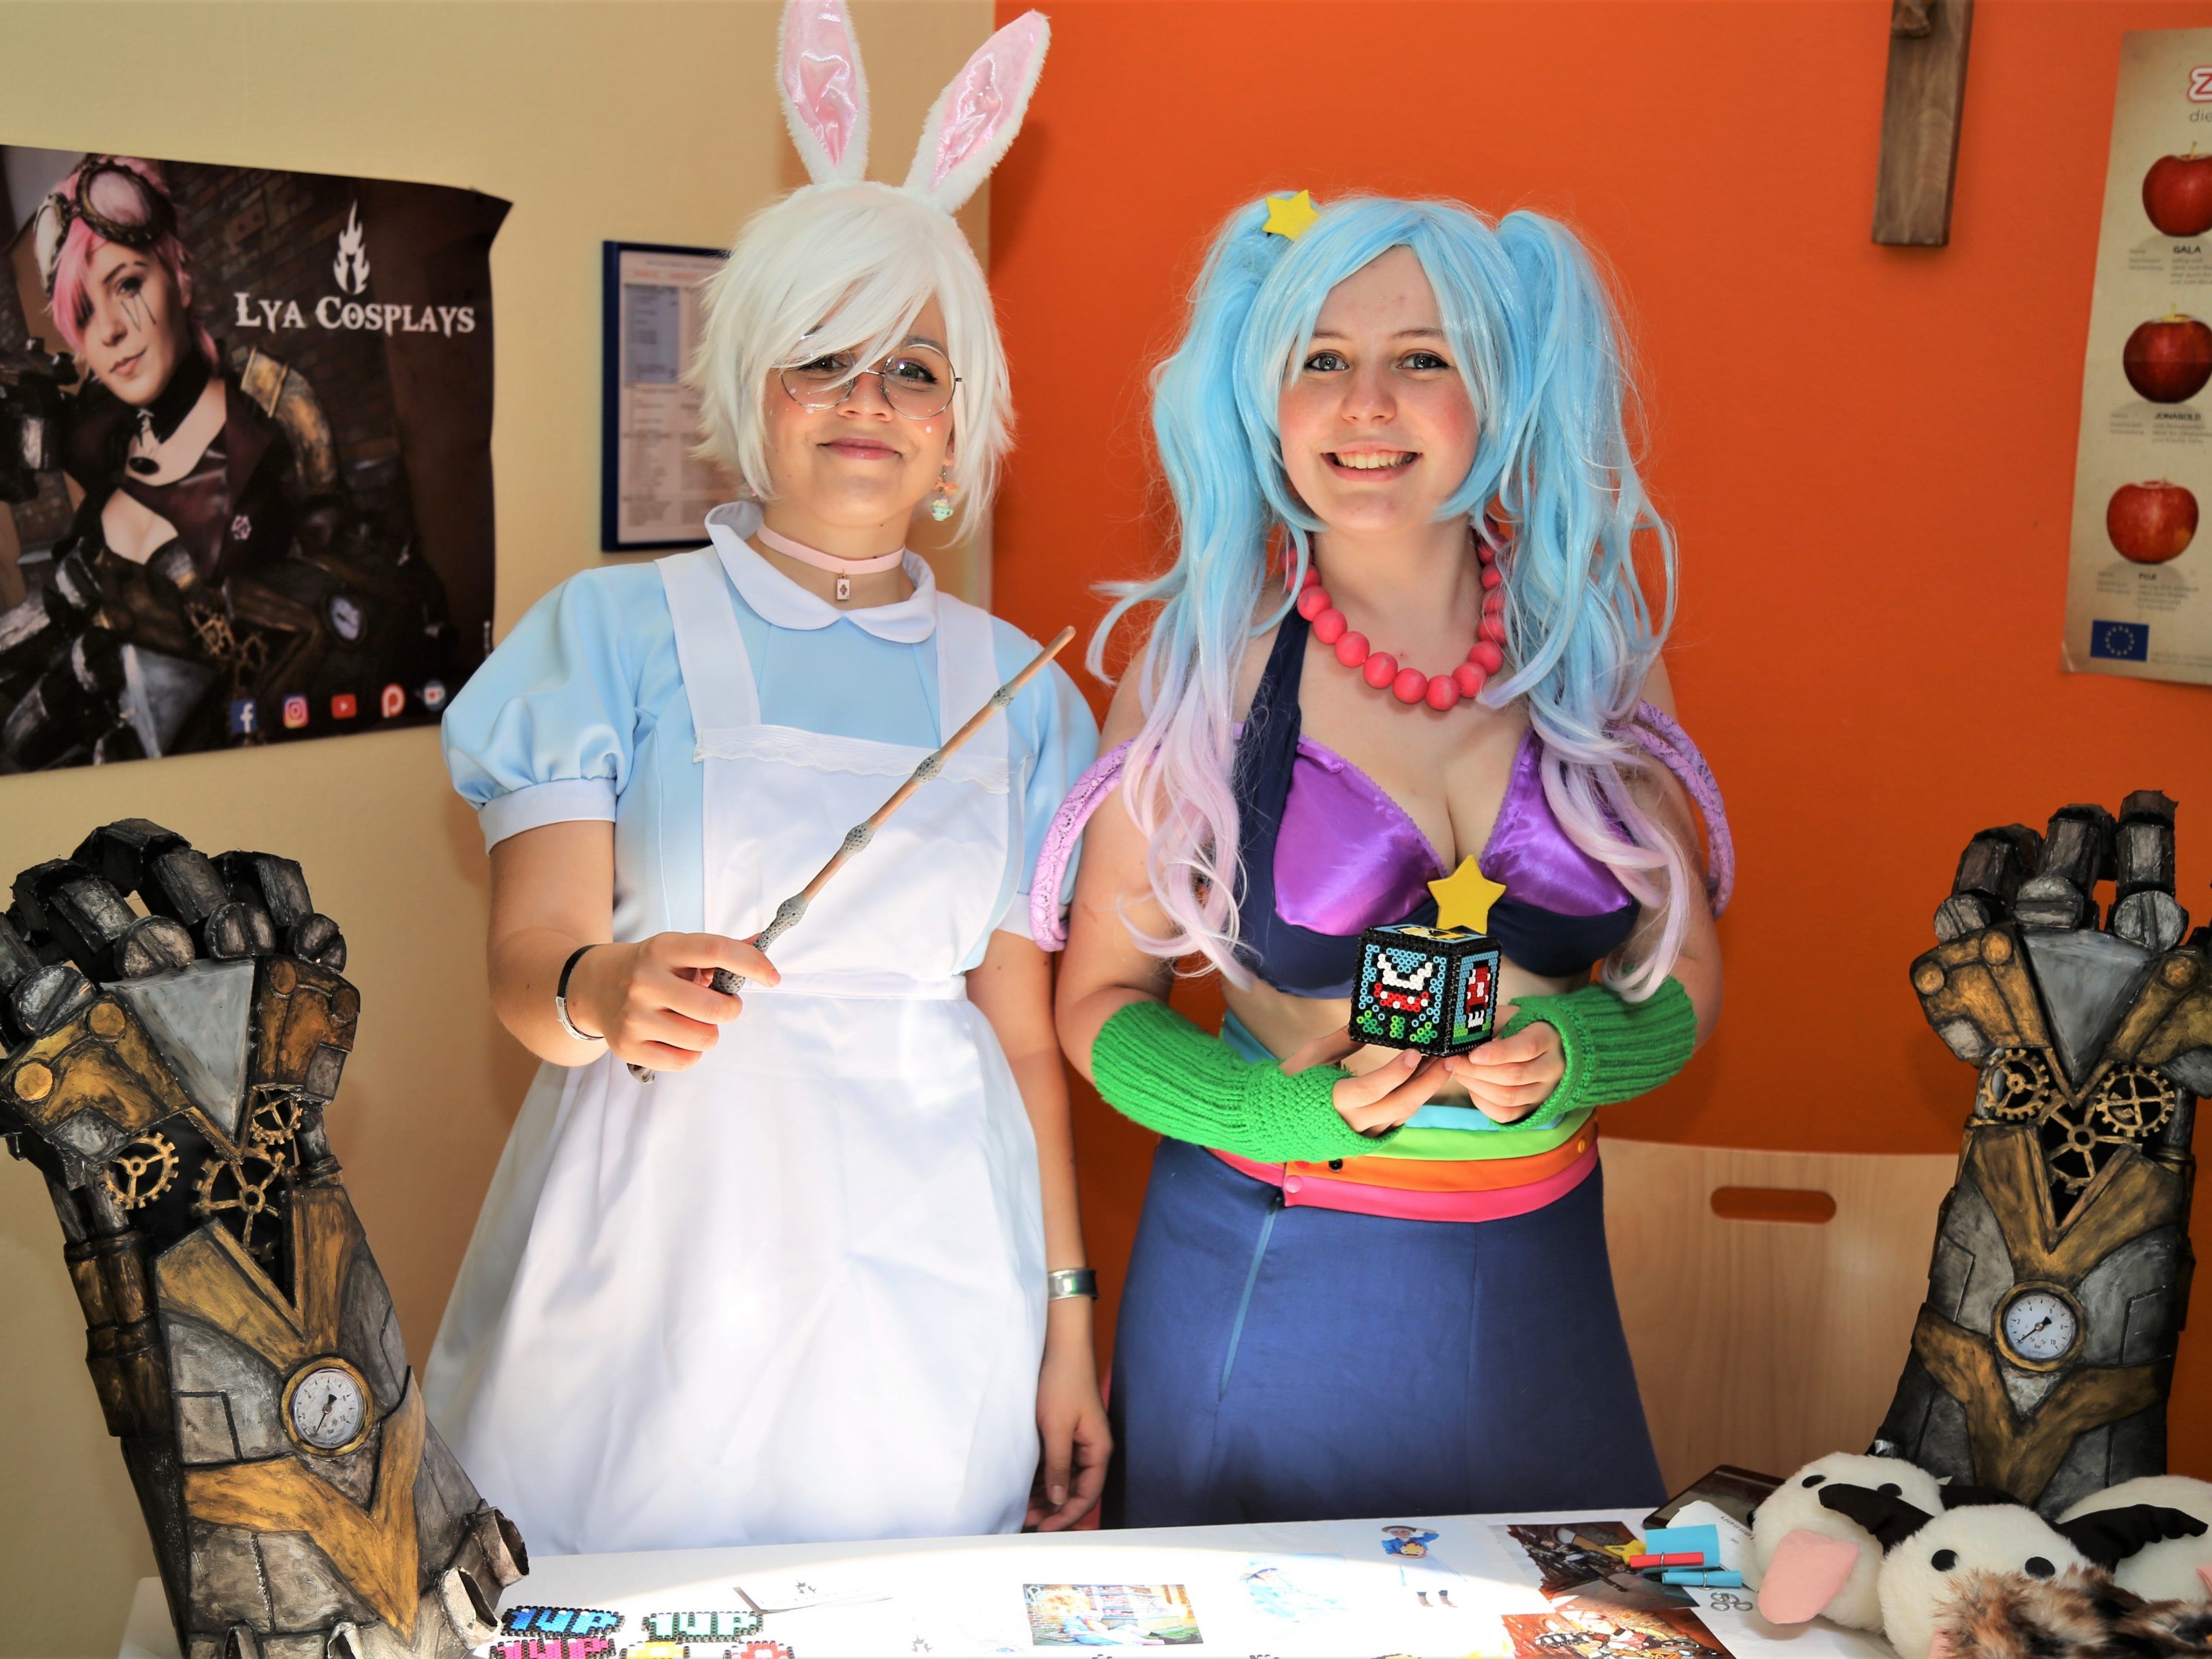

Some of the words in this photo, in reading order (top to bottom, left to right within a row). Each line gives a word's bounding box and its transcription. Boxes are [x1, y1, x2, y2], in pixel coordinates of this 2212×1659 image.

[2173, 245, 2202, 255] GALA
[235, 293, 306, 334] LYA
[315, 296, 476, 338] COSPLAYS
[509, 1607, 620, 1635] 1UP
